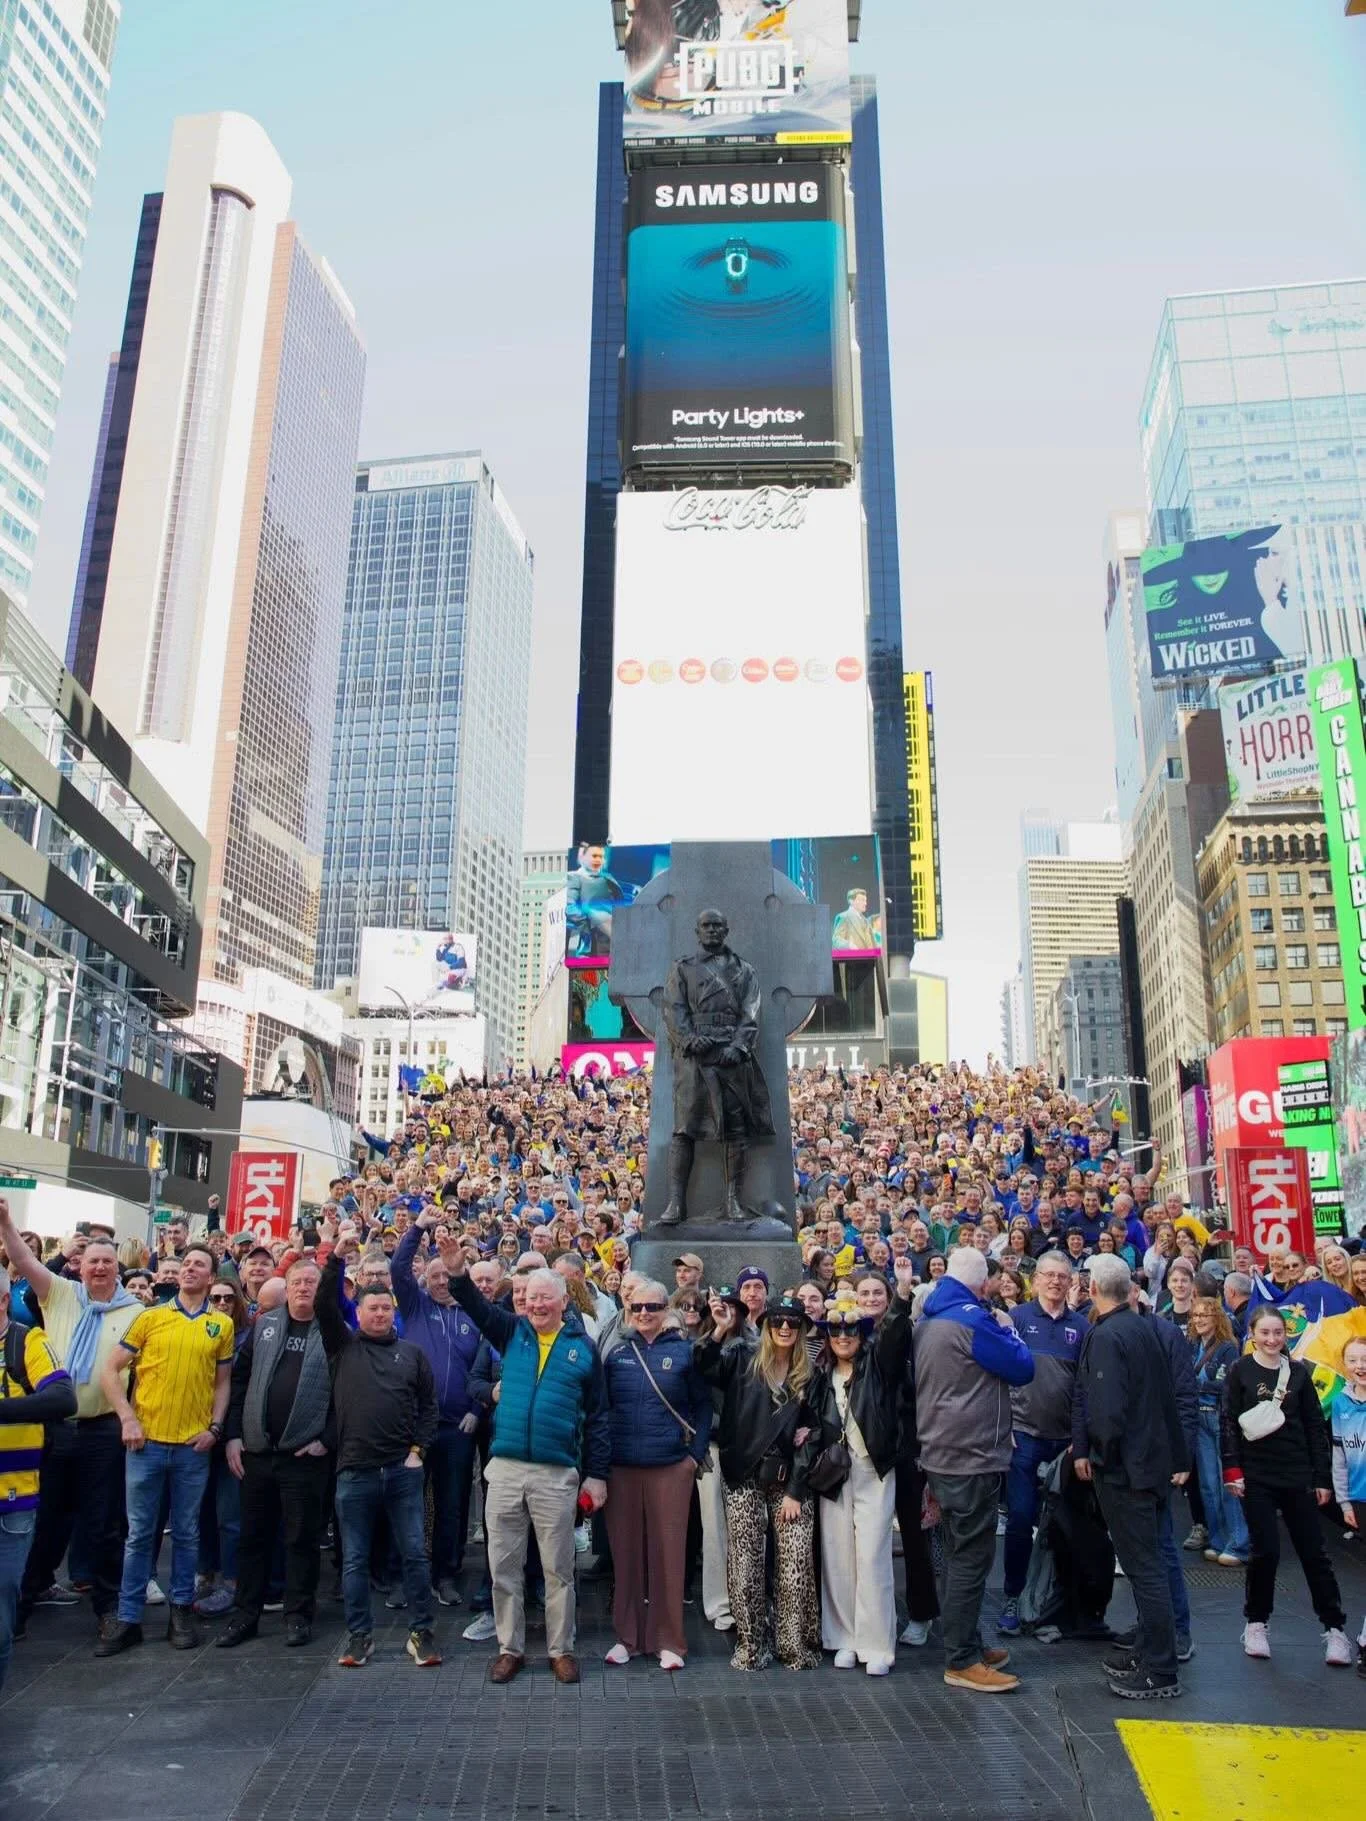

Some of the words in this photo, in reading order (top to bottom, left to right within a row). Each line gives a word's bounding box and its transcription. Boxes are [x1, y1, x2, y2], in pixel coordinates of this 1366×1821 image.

[693, 49, 781, 88] PUBG
[692, 98, 782, 116] MOBILE
[655, 181, 818, 207] SAMSUNG
[672, 409, 729, 429] Party
[733, 407, 805, 428] Lights+
[663, 485, 815, 531] Coca-Cola
[1153, 626, 1199, 641] Remember
[1208, 616, 1255, 632] FOREVER.
[1177, 617, 1193, 628] See
[1203, 611, 1228, 623] LIVE.
[1236, 674, 1306, 721] LITTLE
[1248, 1154, 1296, 1255] tkts
